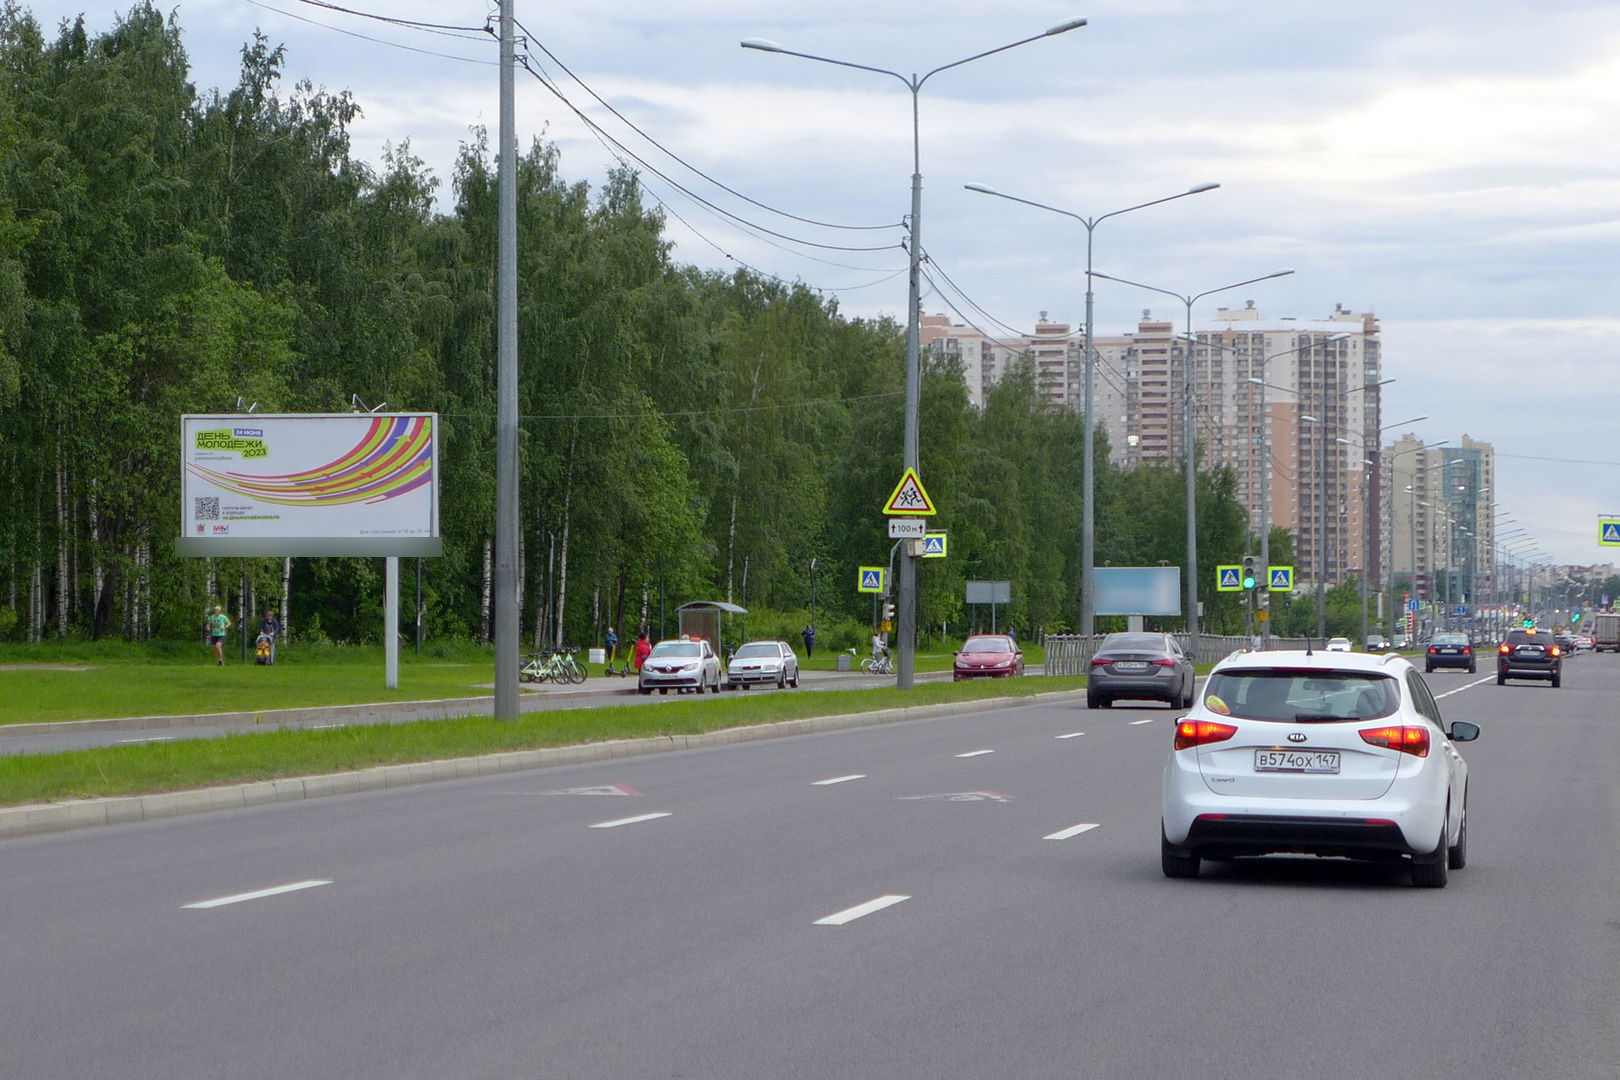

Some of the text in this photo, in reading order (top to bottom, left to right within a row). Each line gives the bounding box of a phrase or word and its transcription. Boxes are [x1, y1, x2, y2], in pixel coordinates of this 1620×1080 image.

[197, 432, 231, 441] ДЕНЬ
[243, 448, 267, 458] 2023
[1260, 752, 1336, 768] В574ОХ 147
